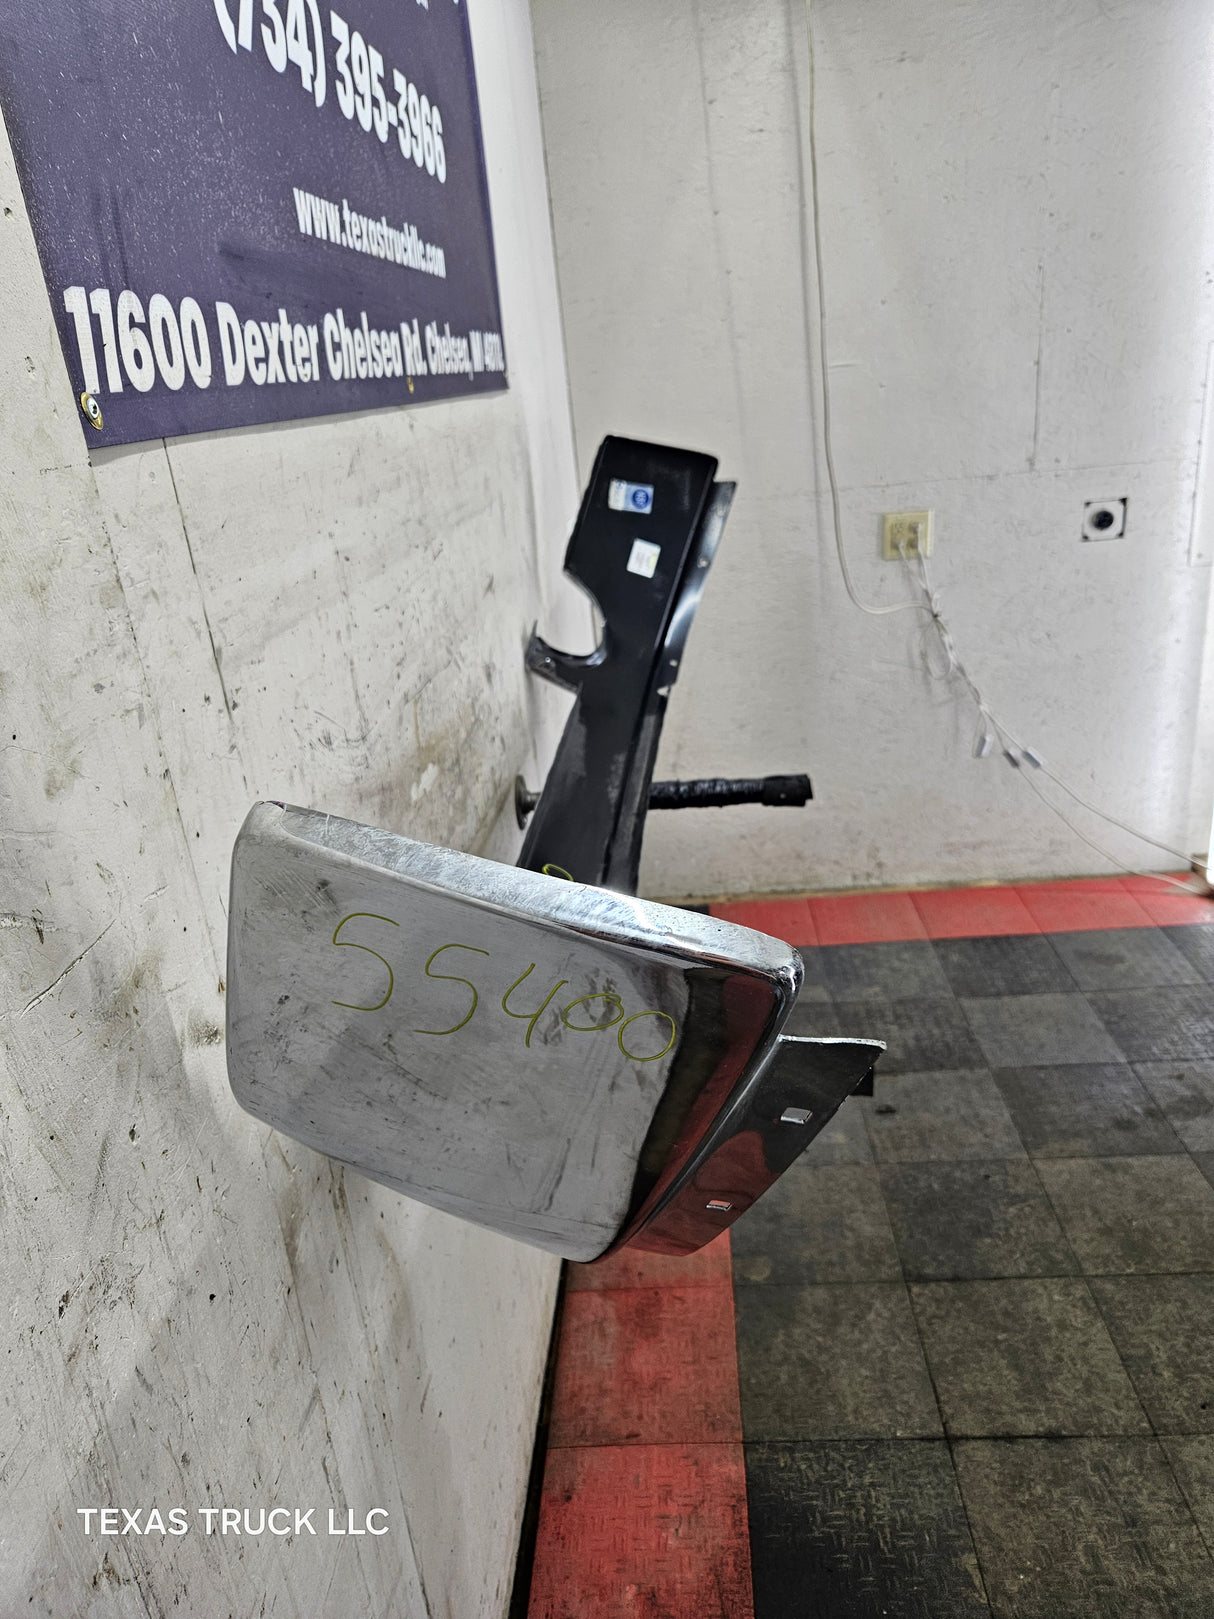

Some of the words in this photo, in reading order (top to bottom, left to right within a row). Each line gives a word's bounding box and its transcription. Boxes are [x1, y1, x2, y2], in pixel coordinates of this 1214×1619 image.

[330, 10, 447, 184] 395-3966
[63, 286, 212, 394] 11600
[216, 301, 320, 386] Dexter
[323, 308, 404, 381] Chelsea
